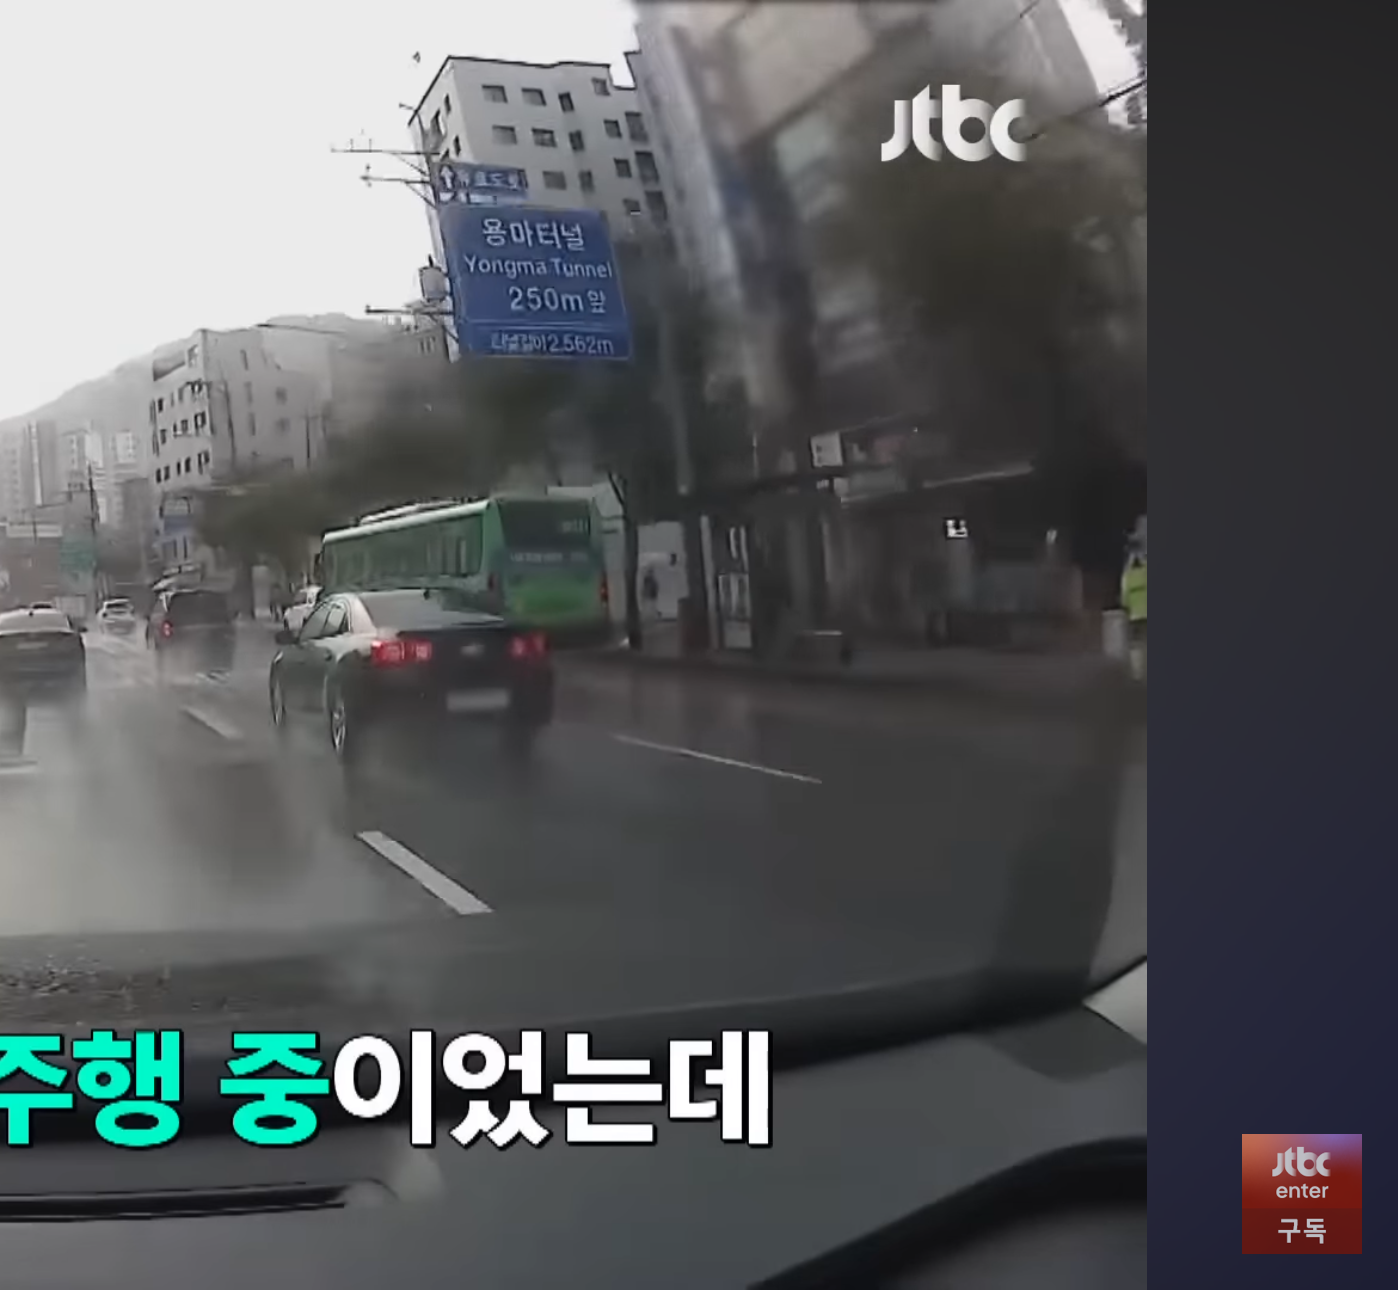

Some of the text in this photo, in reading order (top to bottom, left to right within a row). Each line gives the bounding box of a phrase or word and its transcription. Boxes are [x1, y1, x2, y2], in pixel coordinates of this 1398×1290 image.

[482, 217, 585, 251] 용마터널
[464, 254, 613, 280] Yongma Tunnel
